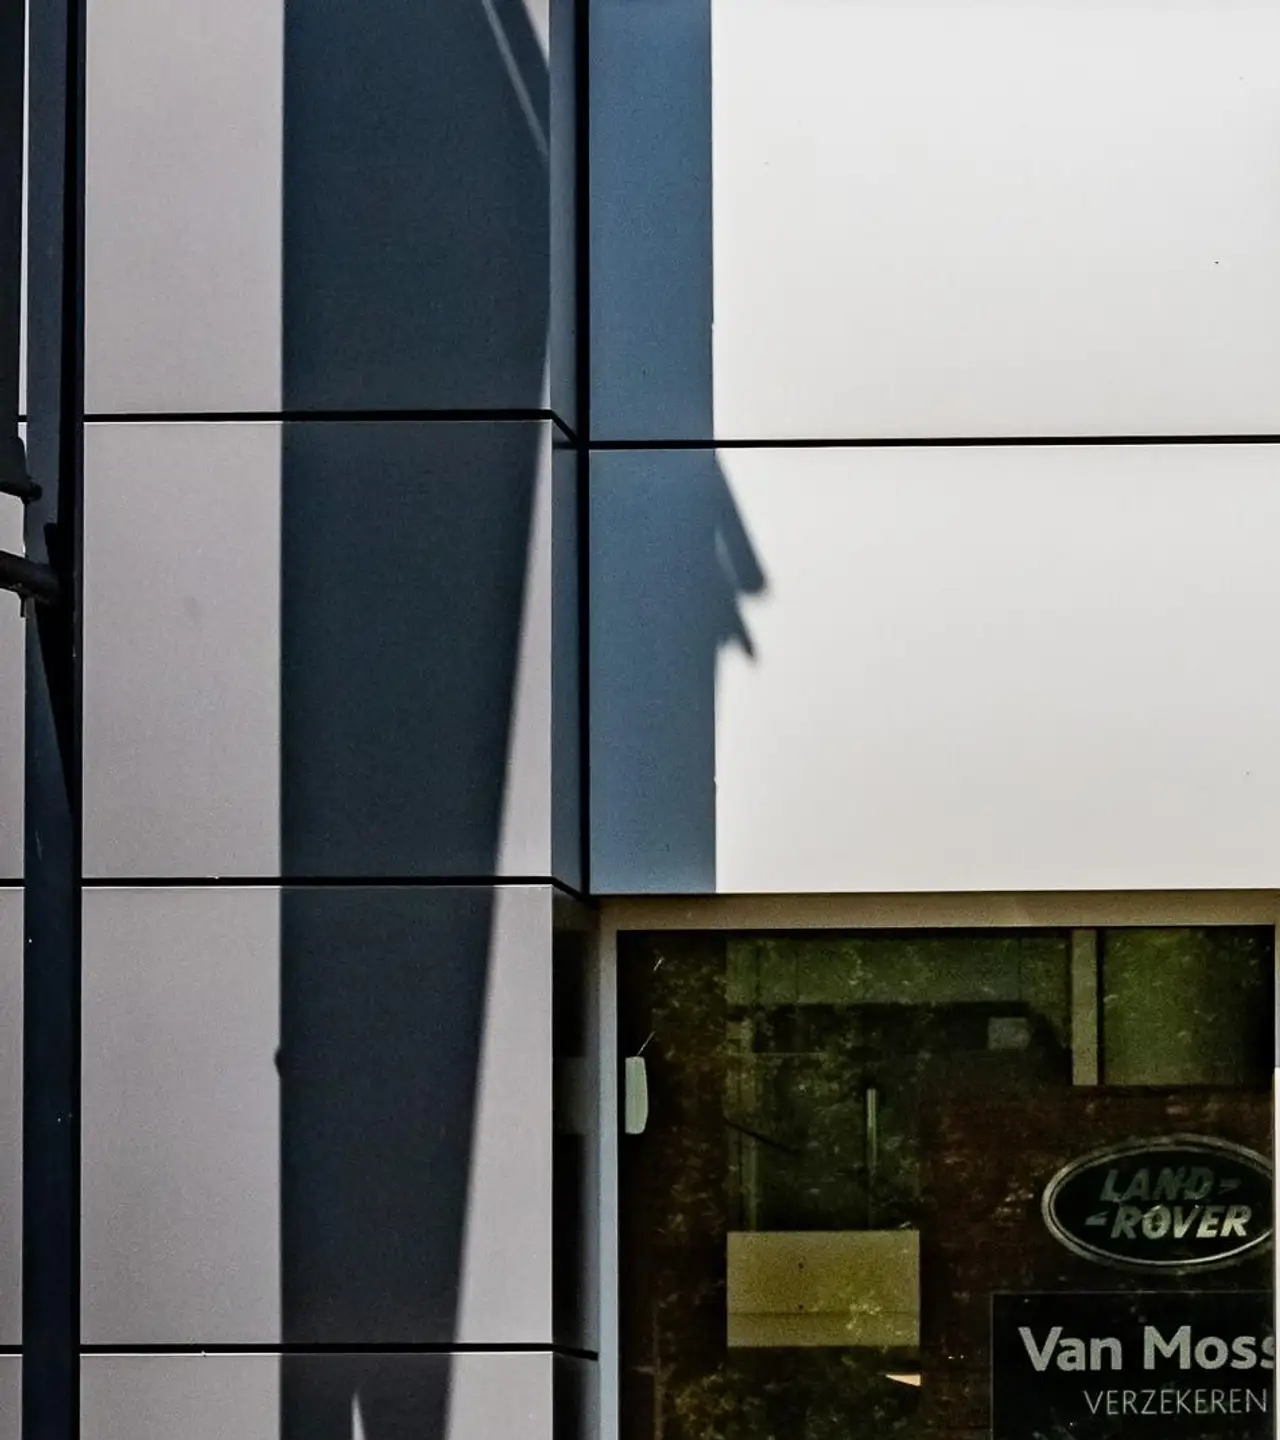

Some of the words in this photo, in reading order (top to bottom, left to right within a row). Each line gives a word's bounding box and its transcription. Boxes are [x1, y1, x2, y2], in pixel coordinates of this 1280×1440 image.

[1101, 1166, 1215, 1201] LAND
[1110, 1204, 1252, 1240] ROVER
[1018, 1326, 1122, 1371] Van
[1083, 1388, 1268, 1416] VERZEKEREN
